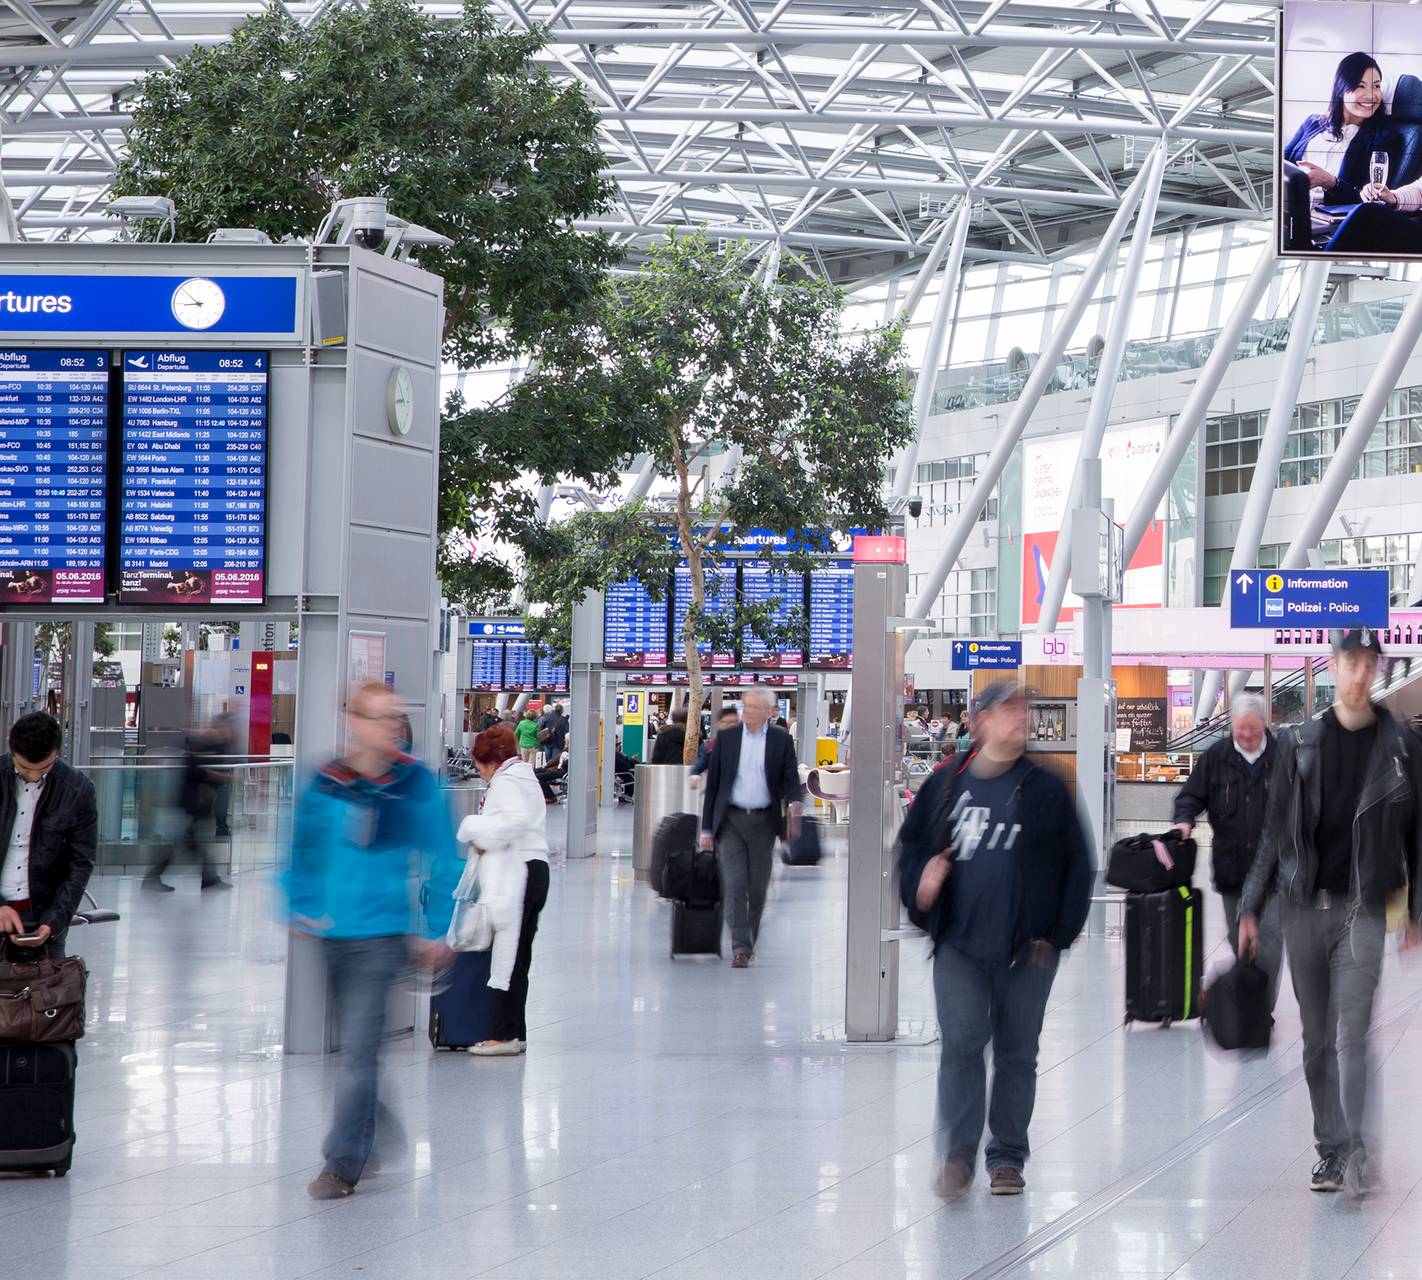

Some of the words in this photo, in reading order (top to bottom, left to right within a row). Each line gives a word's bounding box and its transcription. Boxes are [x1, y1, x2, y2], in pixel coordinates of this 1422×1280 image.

[60, 358, 85, 367] 08:52
[97, 357, 104, 367] 3
[157, 354, 186, 364] Abflug
[219, 359, 243, 368] 08:52
[255, 359, 262, 368] 4
[152, 420, 177, 428] Hamburg
[150, 514, 175, 522] Salzburg
[56, 572, 101, 580] 05.06.2016
[122, 571, 174, 580] TanzTerminal,
[215, 573, 260, 581] 05.06.2016
[122, 579, 141, 587] tanz!
[1288, 578, 1348, 589] Information
[1288, 602, 1322, 613] Polizei
[1329, 602, 1360, 613] Police
